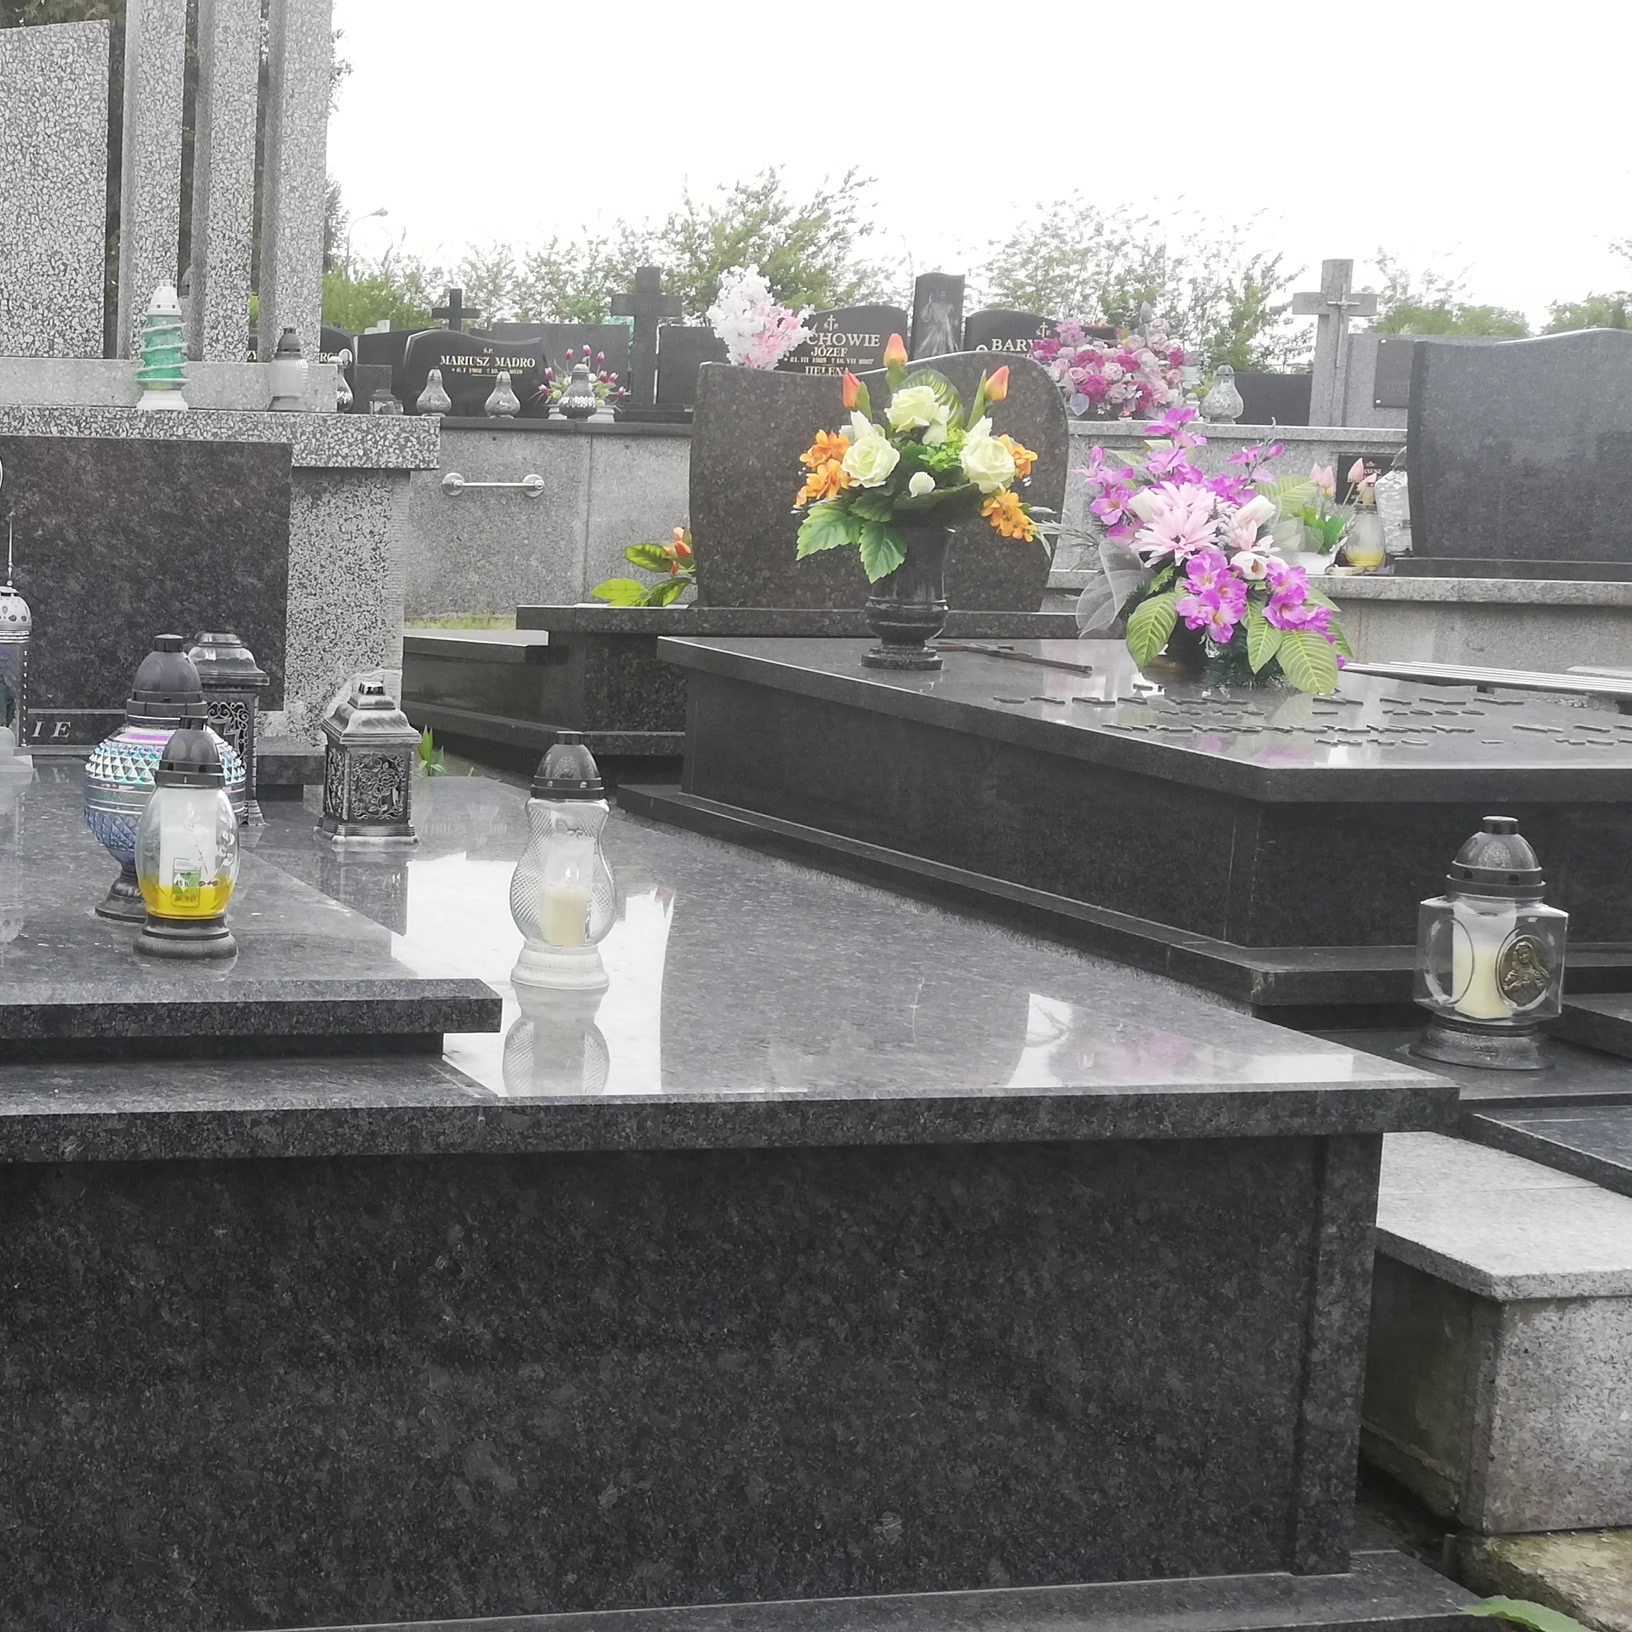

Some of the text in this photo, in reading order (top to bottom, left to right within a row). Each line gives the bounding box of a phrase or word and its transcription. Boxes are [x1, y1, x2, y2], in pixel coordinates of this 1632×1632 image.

[811, 344, 848, 357] JÓZEF
[440, 355, 536, 369] MARIUSZ MĄDRO
